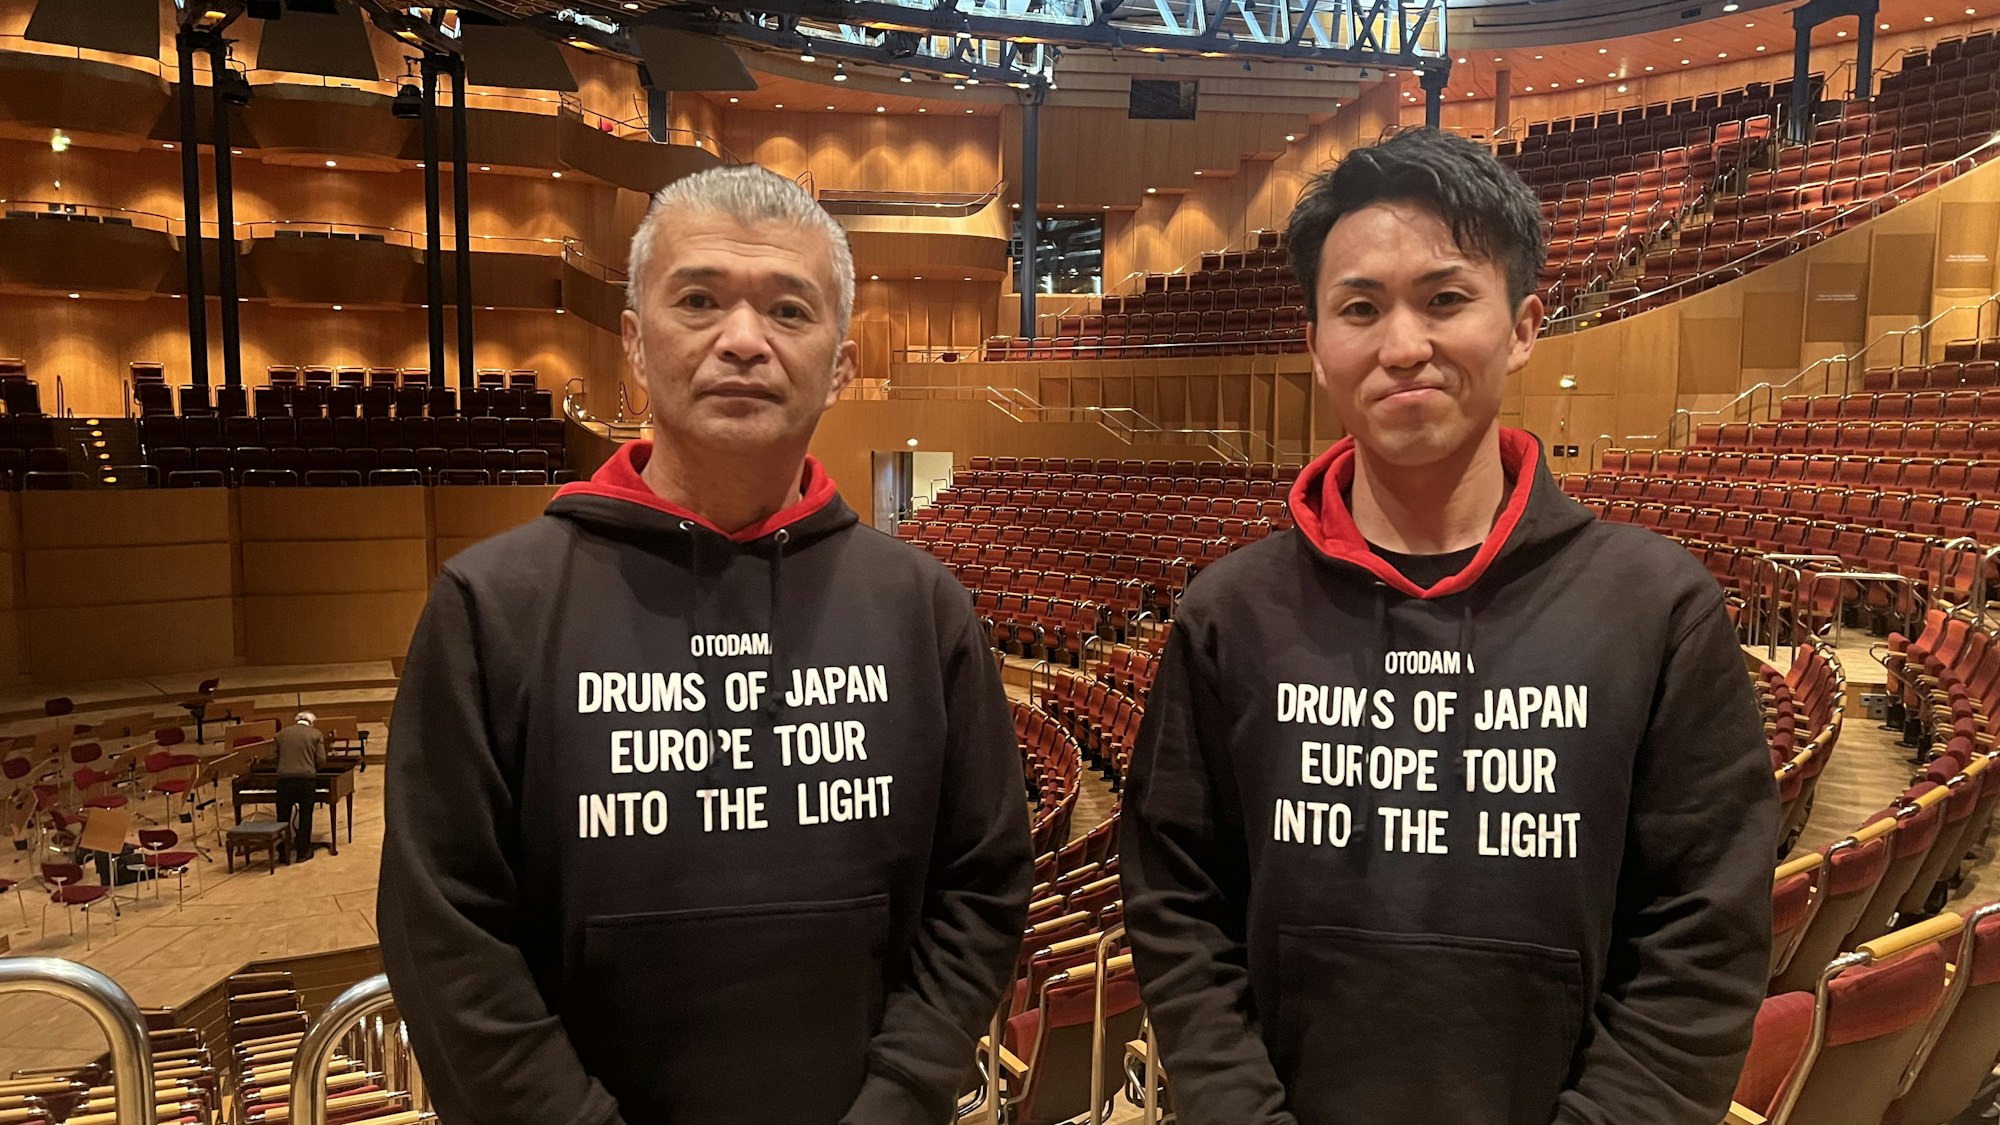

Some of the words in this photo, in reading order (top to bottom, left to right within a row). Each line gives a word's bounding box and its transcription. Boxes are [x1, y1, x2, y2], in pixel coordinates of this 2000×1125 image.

[690, 632, 773, 657] OTODAM
[578, 671, 707, 714] DRUMS
[724, 670, 768, 713] OF
[784, 664, 888, 708] JAPAN
[1277, 682, 1395, 730] DRUMS
[1413, 690, 1458, 733] OF
[1474, 684, 1588, 731] JAPAN
[773, 720, 868, 767] TOUR
[1301, 740, 1439, 792] EUROPE
[1462, 747, 1557, 794] TOUR
[578, 790, 668, 839] INTO
[695, 785, 769, 832] THE
[797, 775, 894, 825] LIGHT
[1273, 798, 1352, 848] INTO
[1377, 806, 1449, 855] THE
[1478, 810, 1581, 859] LIGHT
